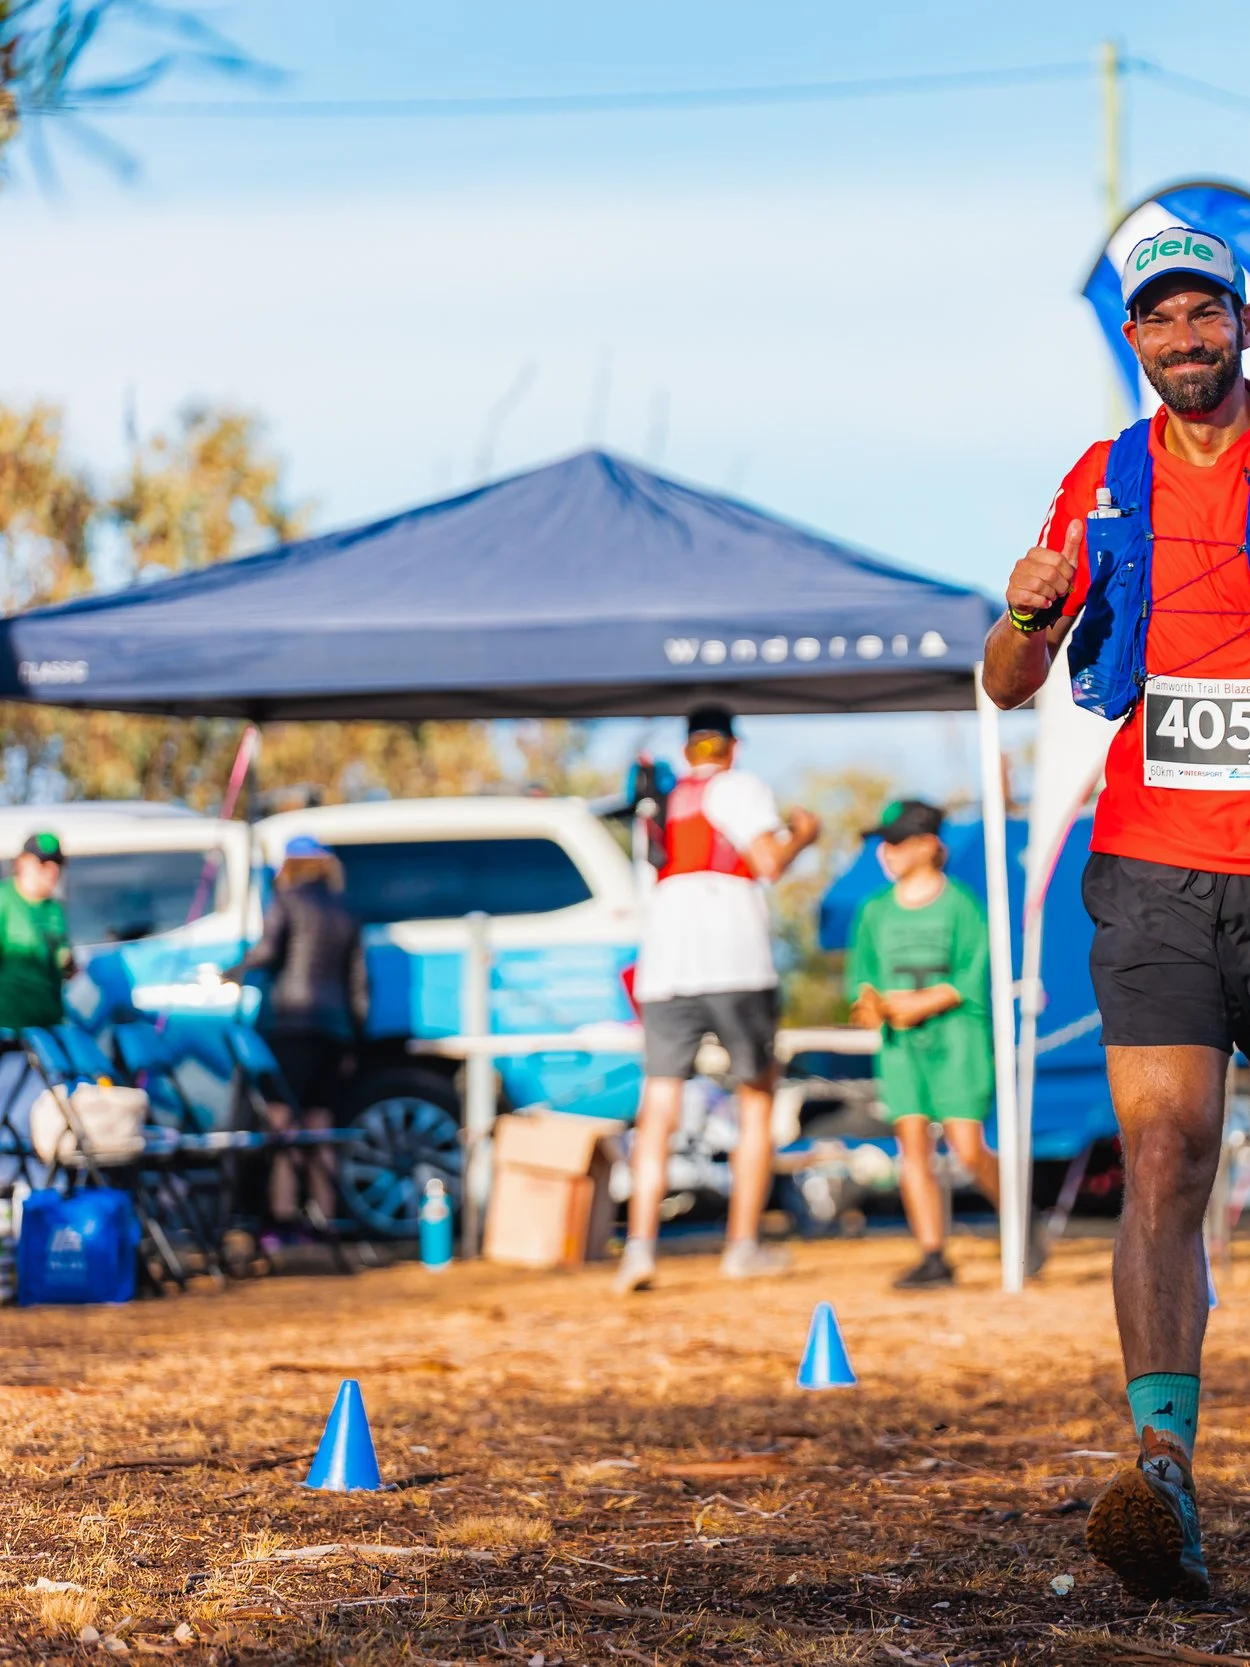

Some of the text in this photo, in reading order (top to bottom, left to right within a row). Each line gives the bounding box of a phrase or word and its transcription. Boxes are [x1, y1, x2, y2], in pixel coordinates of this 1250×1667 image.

[1136, 236, 1214, 271] ciele
[1152, 679, 1194, 693] Tamworth
[1197, 682, 1220, 694] Trail
[1150, 765, 1174, 778] 60km
